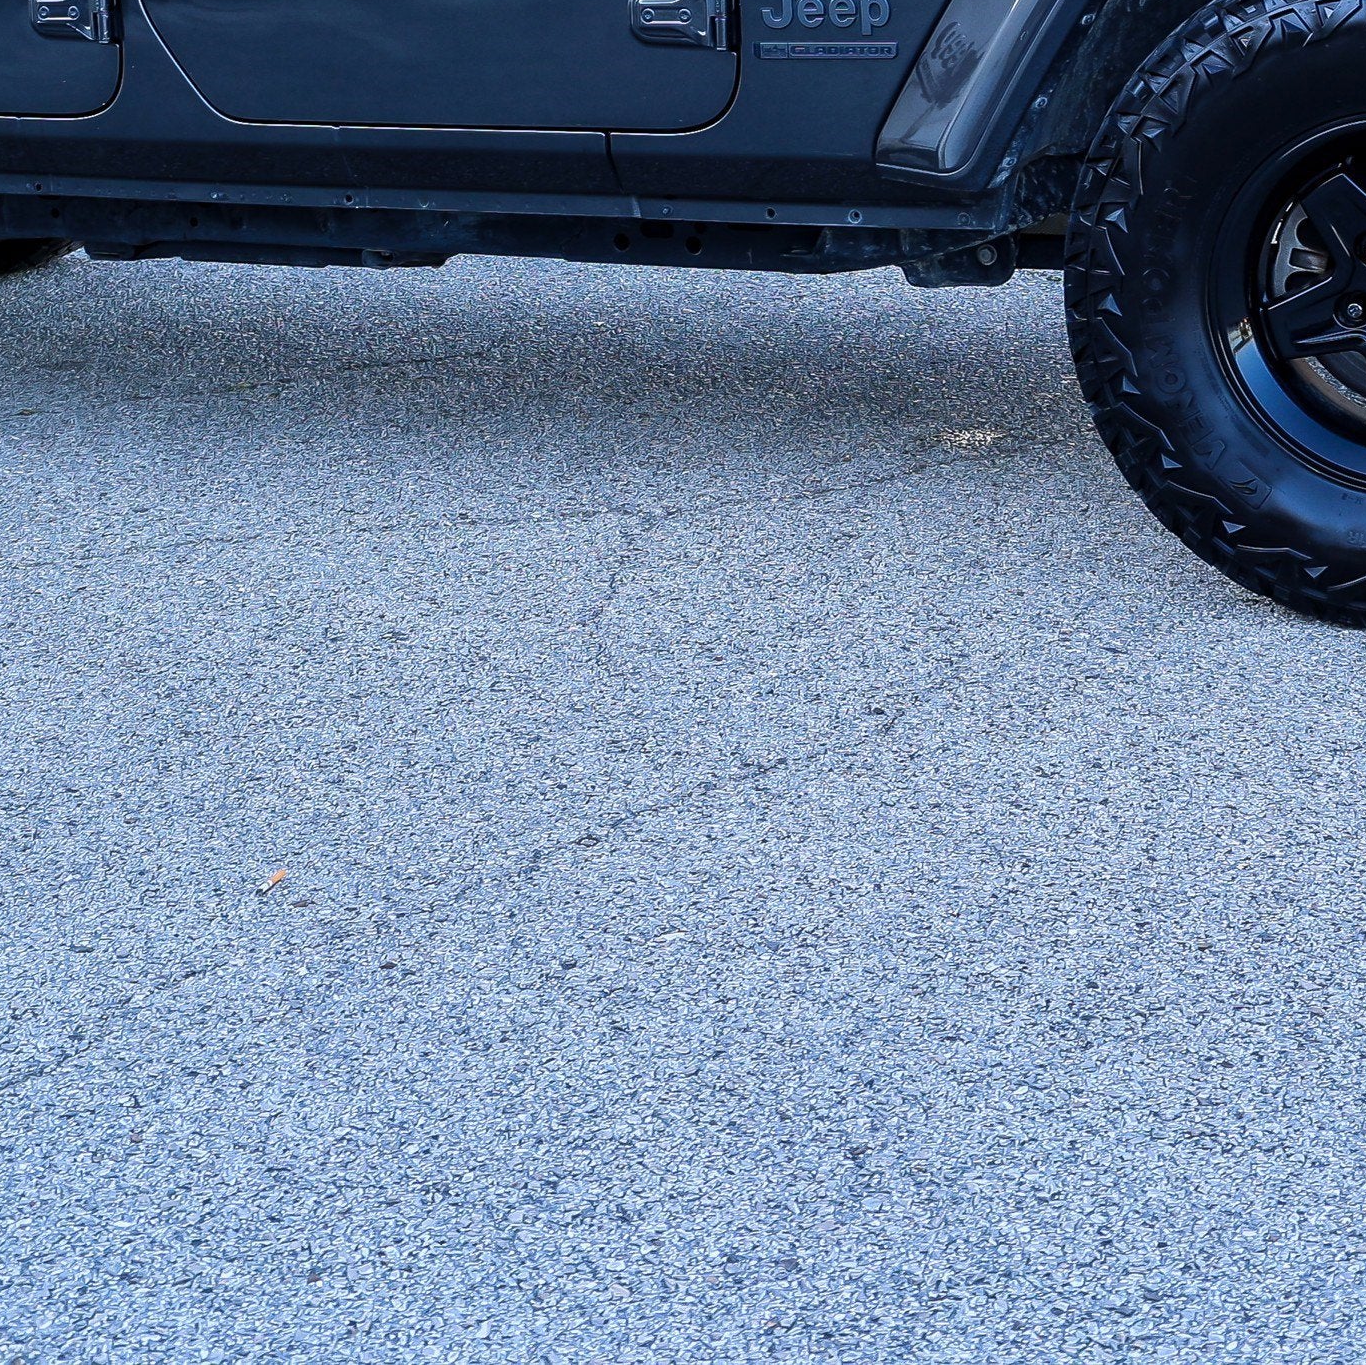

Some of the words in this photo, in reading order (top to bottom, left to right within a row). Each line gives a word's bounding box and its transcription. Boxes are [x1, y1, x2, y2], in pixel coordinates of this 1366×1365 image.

[789, 44, 893, 56] GLADIATOR
[1140, 172, 1195, 326] POWER
[1143, 331, 1227, 473] VENOM
